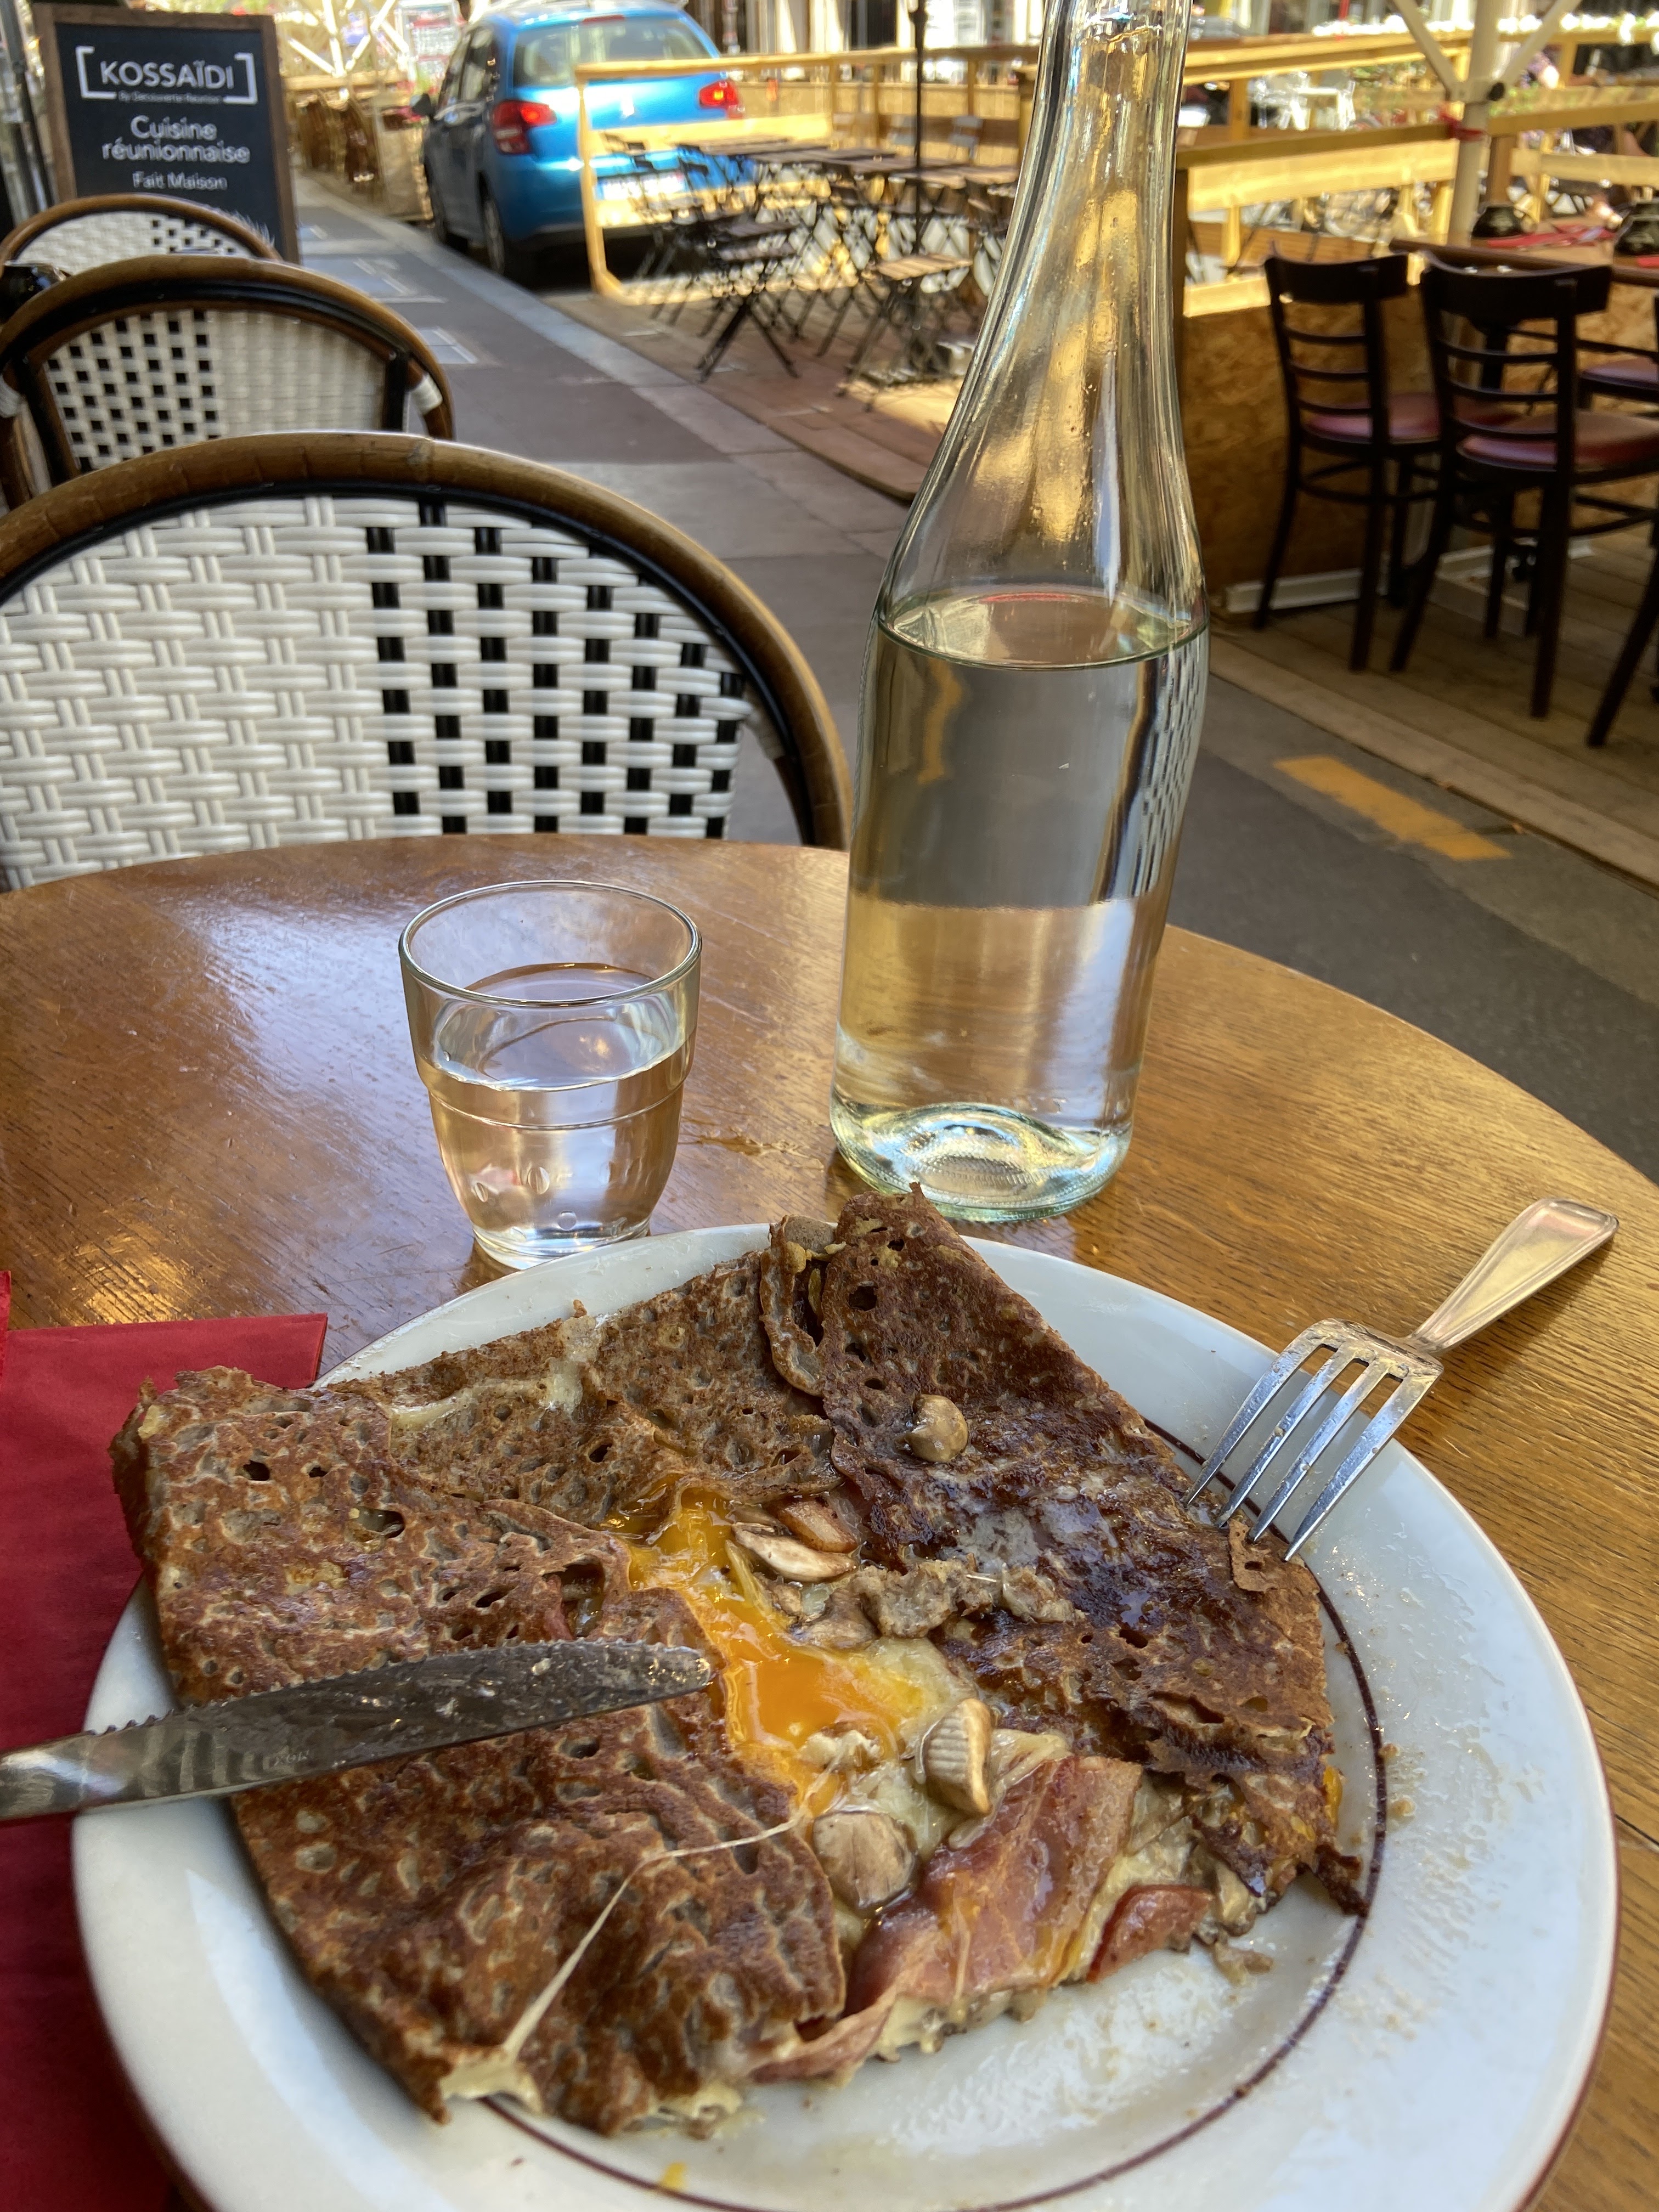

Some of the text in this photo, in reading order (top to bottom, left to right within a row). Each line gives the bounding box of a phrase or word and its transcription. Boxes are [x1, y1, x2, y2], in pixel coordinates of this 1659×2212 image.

[100, 60, 234, 89] KOSSAÏDI
[131, 115, 217, 140] Cuisine
[101, 137, 250, 163] réunionnaise
[132, 171, 228, 190] Fait Maison
